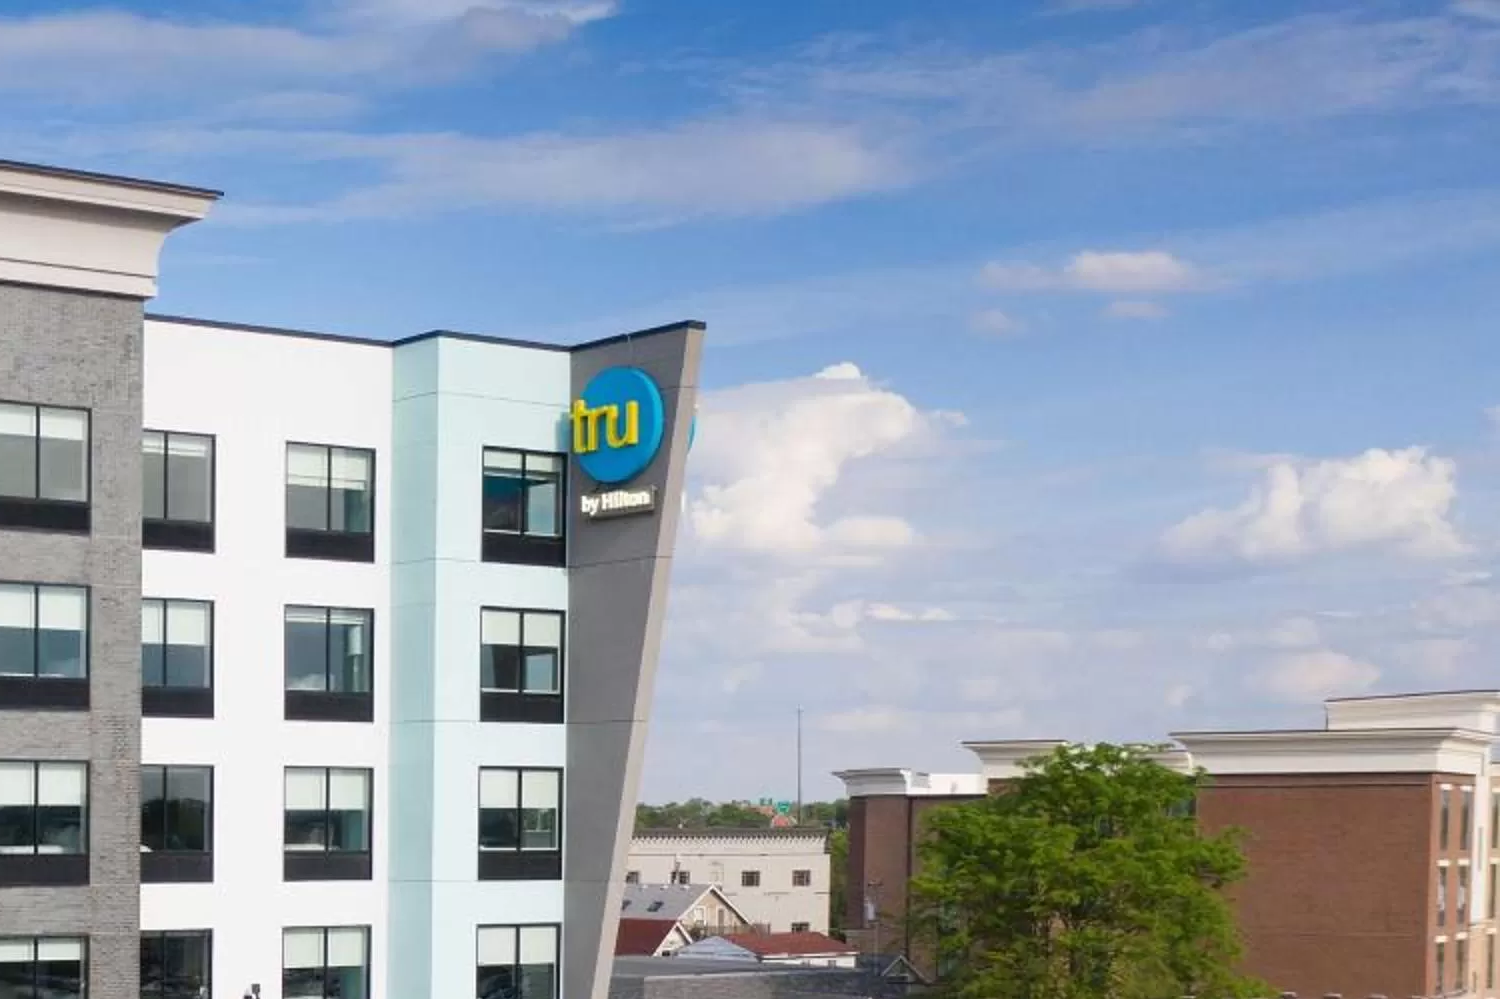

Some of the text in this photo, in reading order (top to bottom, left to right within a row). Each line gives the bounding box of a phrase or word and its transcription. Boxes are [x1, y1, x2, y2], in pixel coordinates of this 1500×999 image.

[571, 399, 639, 453] tru
[581, 490, 650, 515] by Hilton
